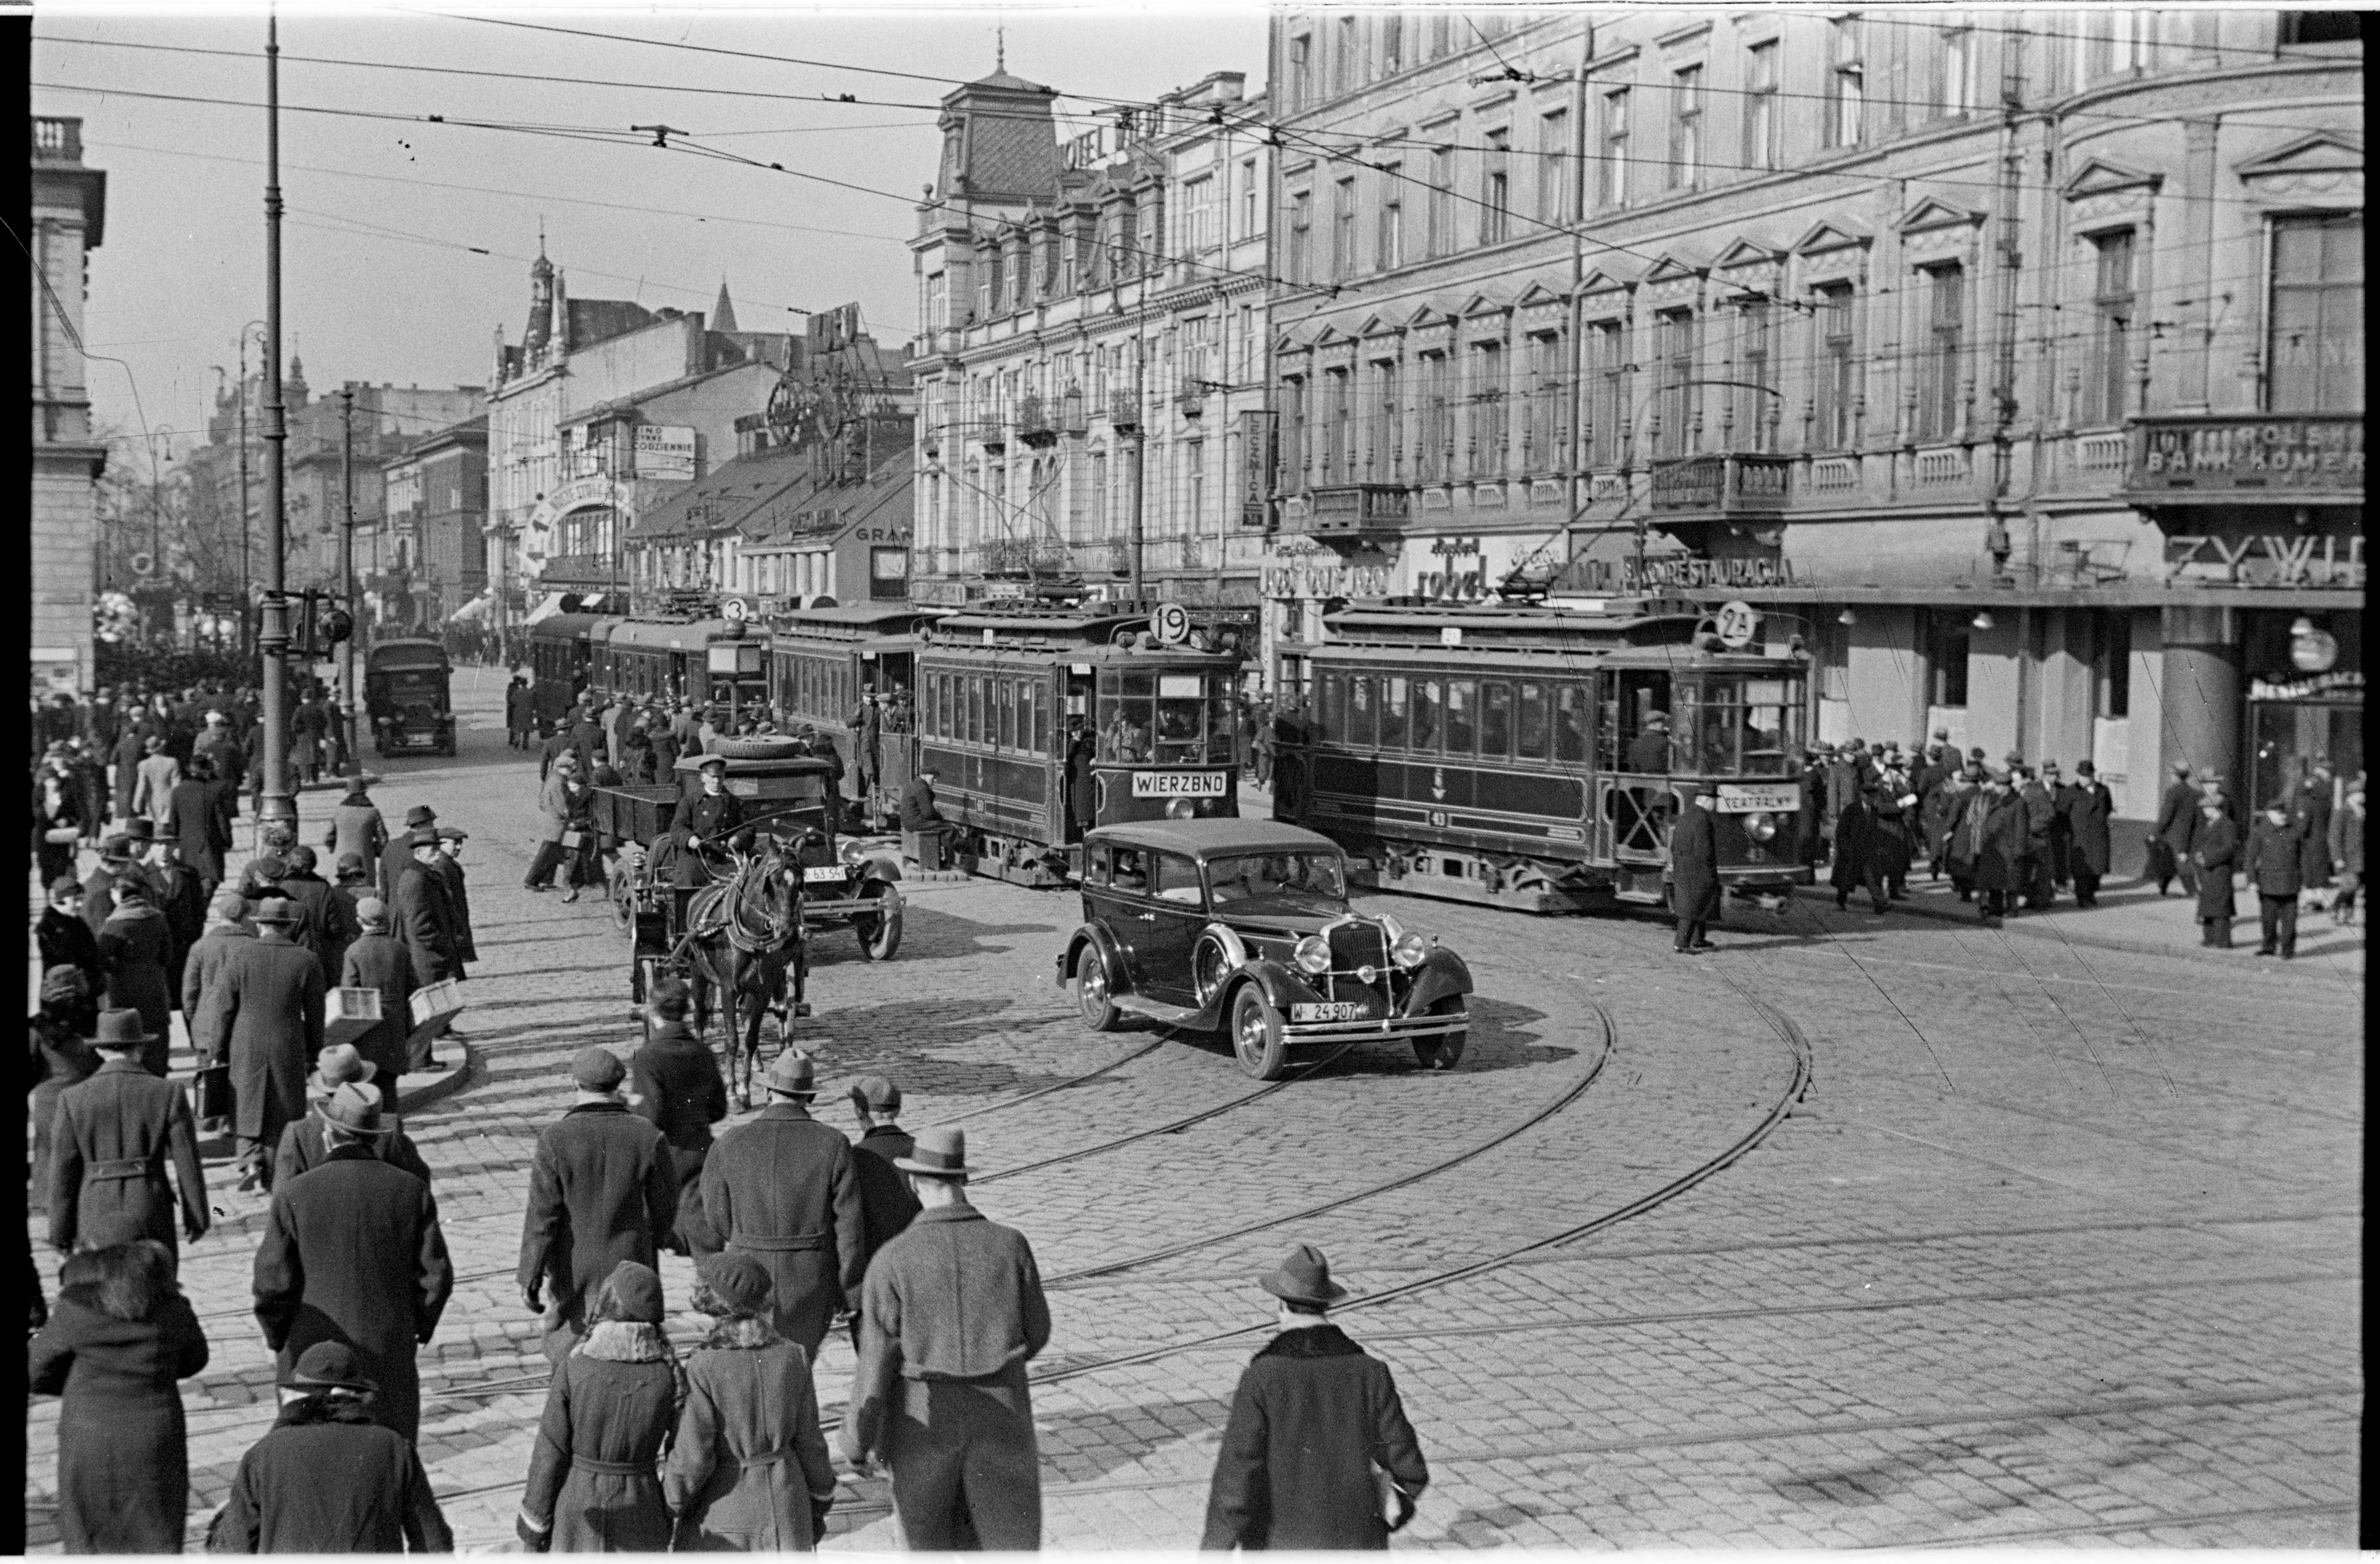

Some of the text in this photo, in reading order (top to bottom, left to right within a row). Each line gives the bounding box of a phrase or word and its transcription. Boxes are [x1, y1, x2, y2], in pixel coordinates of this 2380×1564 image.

[631, 441, 693, 452] CODZIENNIE
[728, 601, 742, 618] 3
[1156, 607, 1186, 640] 19
[1136, 775, 1223, 792] WIERZBNO
[813, 869, 825, 879] 63
